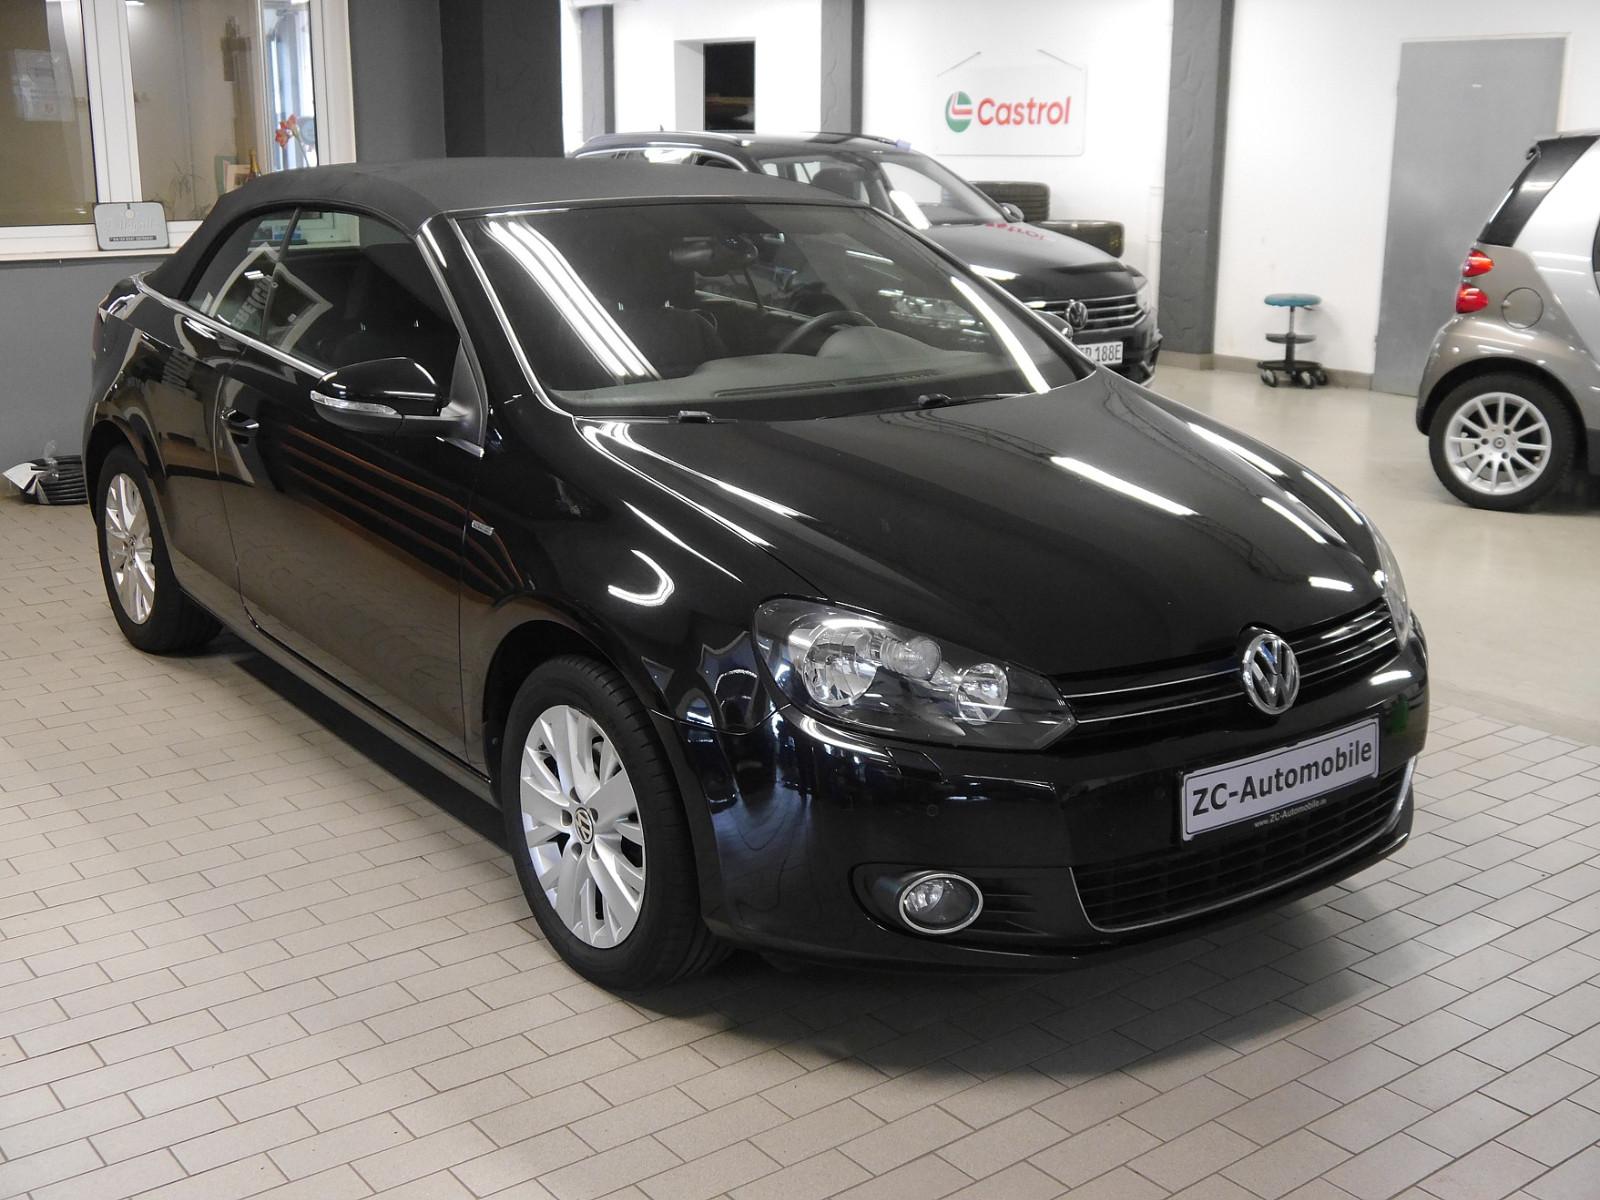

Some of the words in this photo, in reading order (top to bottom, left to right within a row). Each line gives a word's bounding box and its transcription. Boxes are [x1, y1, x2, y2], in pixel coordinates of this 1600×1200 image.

[977, 96, 1071, 126] Castrol
[1095, 343, 1122, 362] 188E
[1192, 740, 1372, 816] ZC-Automobile
